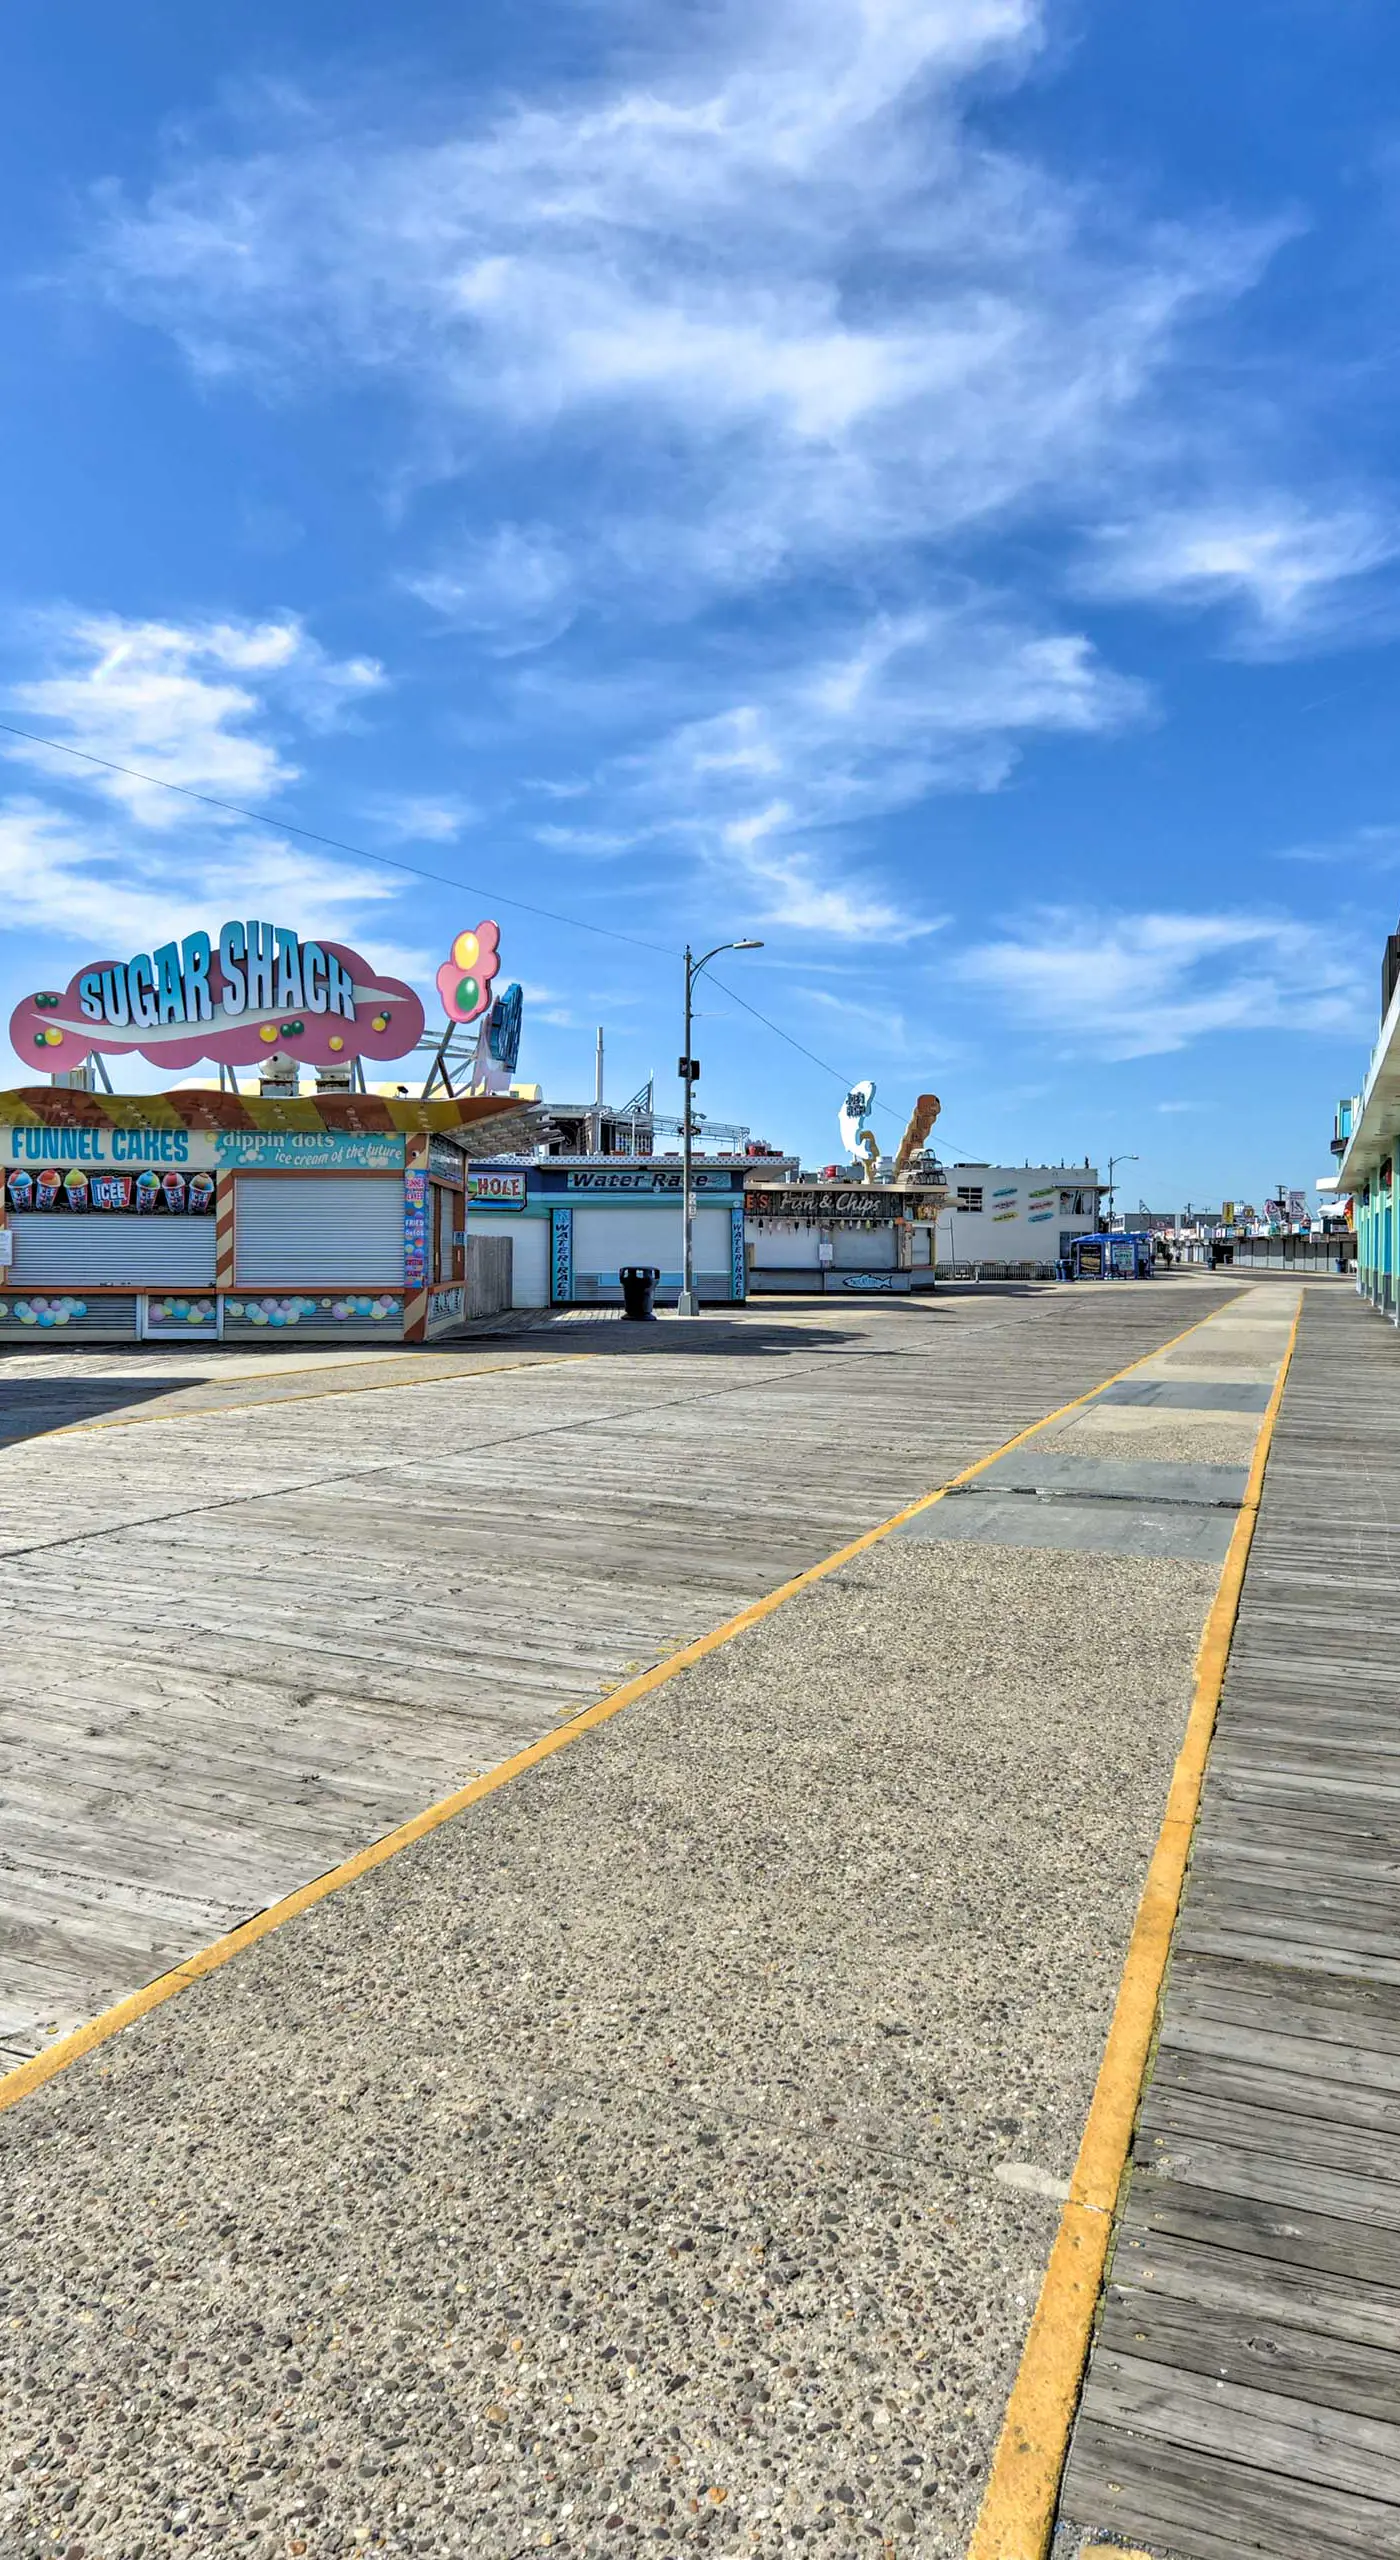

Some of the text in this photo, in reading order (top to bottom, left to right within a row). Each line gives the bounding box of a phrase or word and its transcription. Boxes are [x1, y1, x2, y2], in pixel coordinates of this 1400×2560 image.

[79, 920, 355, 1028] SUGAR SHACK
[12, 1127, 189, 1162] FUNNEL CAKES
[291, 1132, 336, 1148] dots
[275, 1142, 402, 1165] ice cream of the future
[477, 1177, 521, 1196] HOLE
[572, 1172, 709, 1187] Water Rae
[96, 1182, 128, 1201] ICEE
[780, 1191, 816, 1210] Fish
[819, 1194, 833, 1208] &
[835, 1192, 880, 1215] Chips
[556, 1224, 569, 1297] WATER RACE
[734, 1223, 743, 1296] WATER RACE
